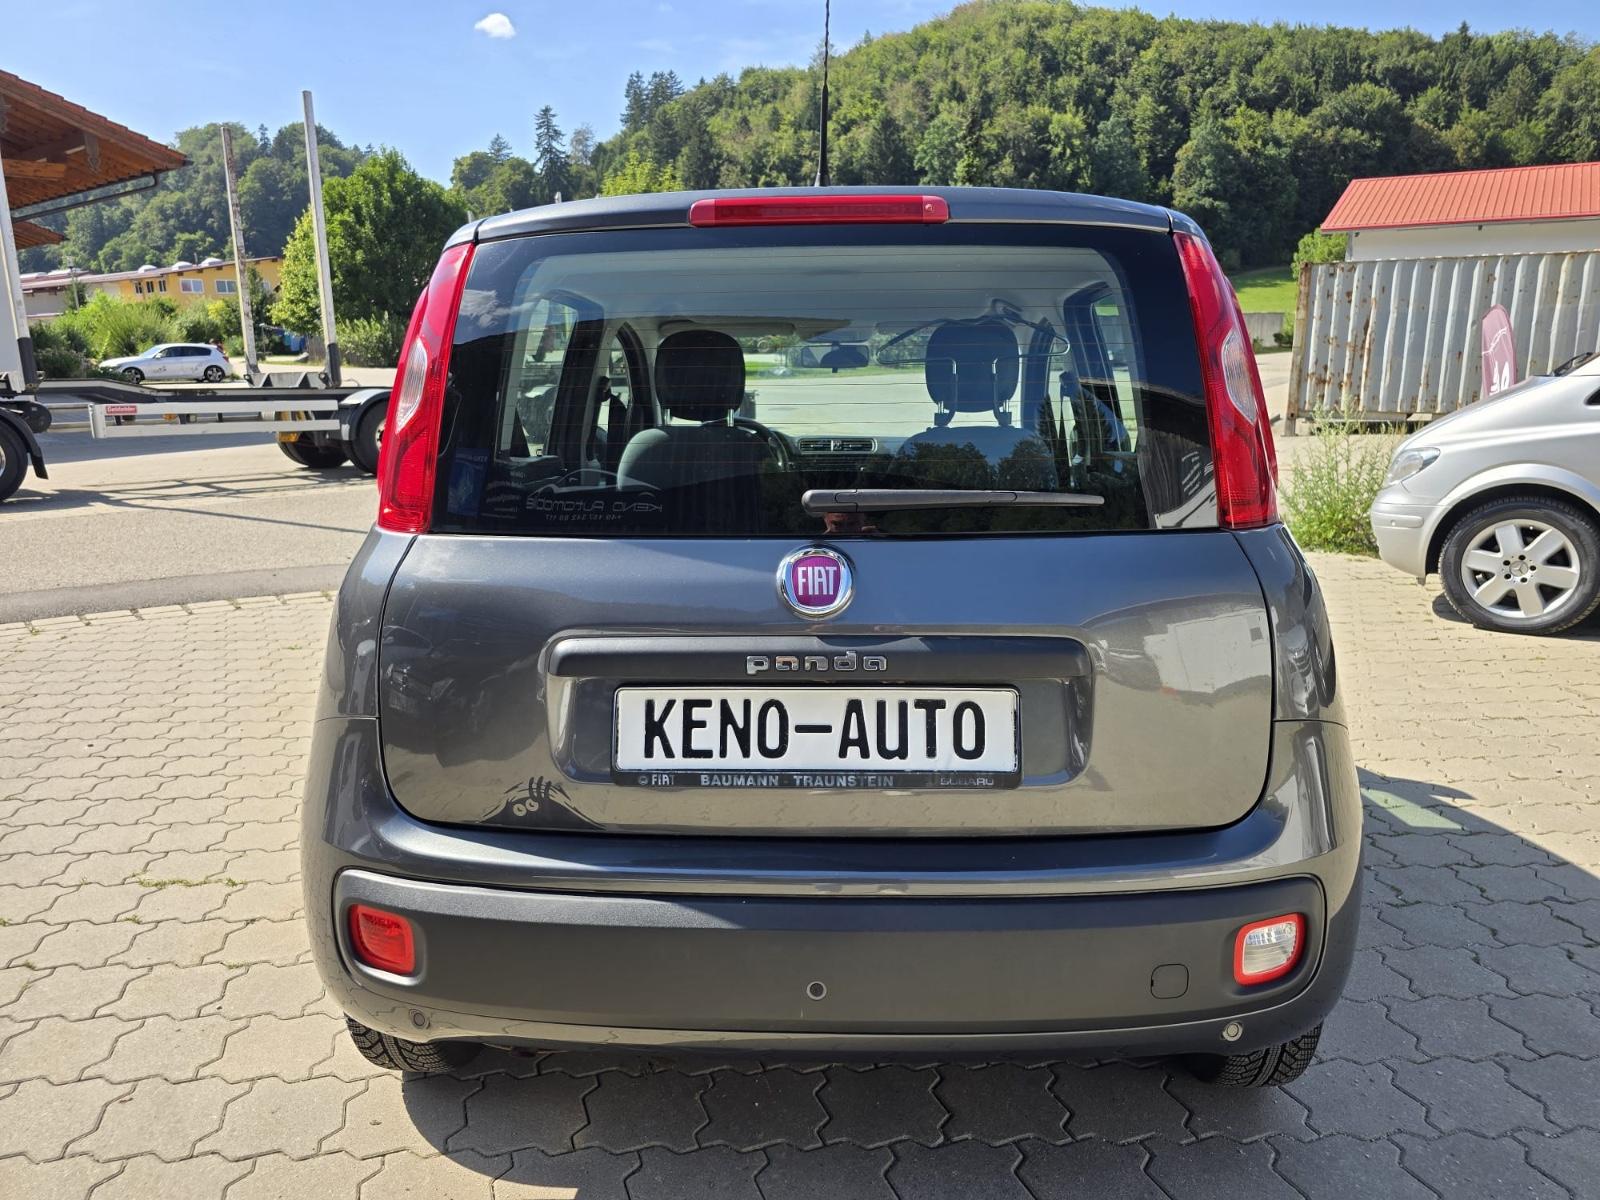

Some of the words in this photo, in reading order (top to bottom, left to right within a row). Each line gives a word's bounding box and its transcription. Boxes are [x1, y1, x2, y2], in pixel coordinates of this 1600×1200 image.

[797, 565, 838, 596] FIAT
[745, 650, 888, 675] panda
[643, 699, 986, 760] KENO-AUTO
[651, 774, 675, 786] FIAT
[700, 774, 779, 786] BAUMANN
[793, 775, 894, 787] TRAUNSTEIN
